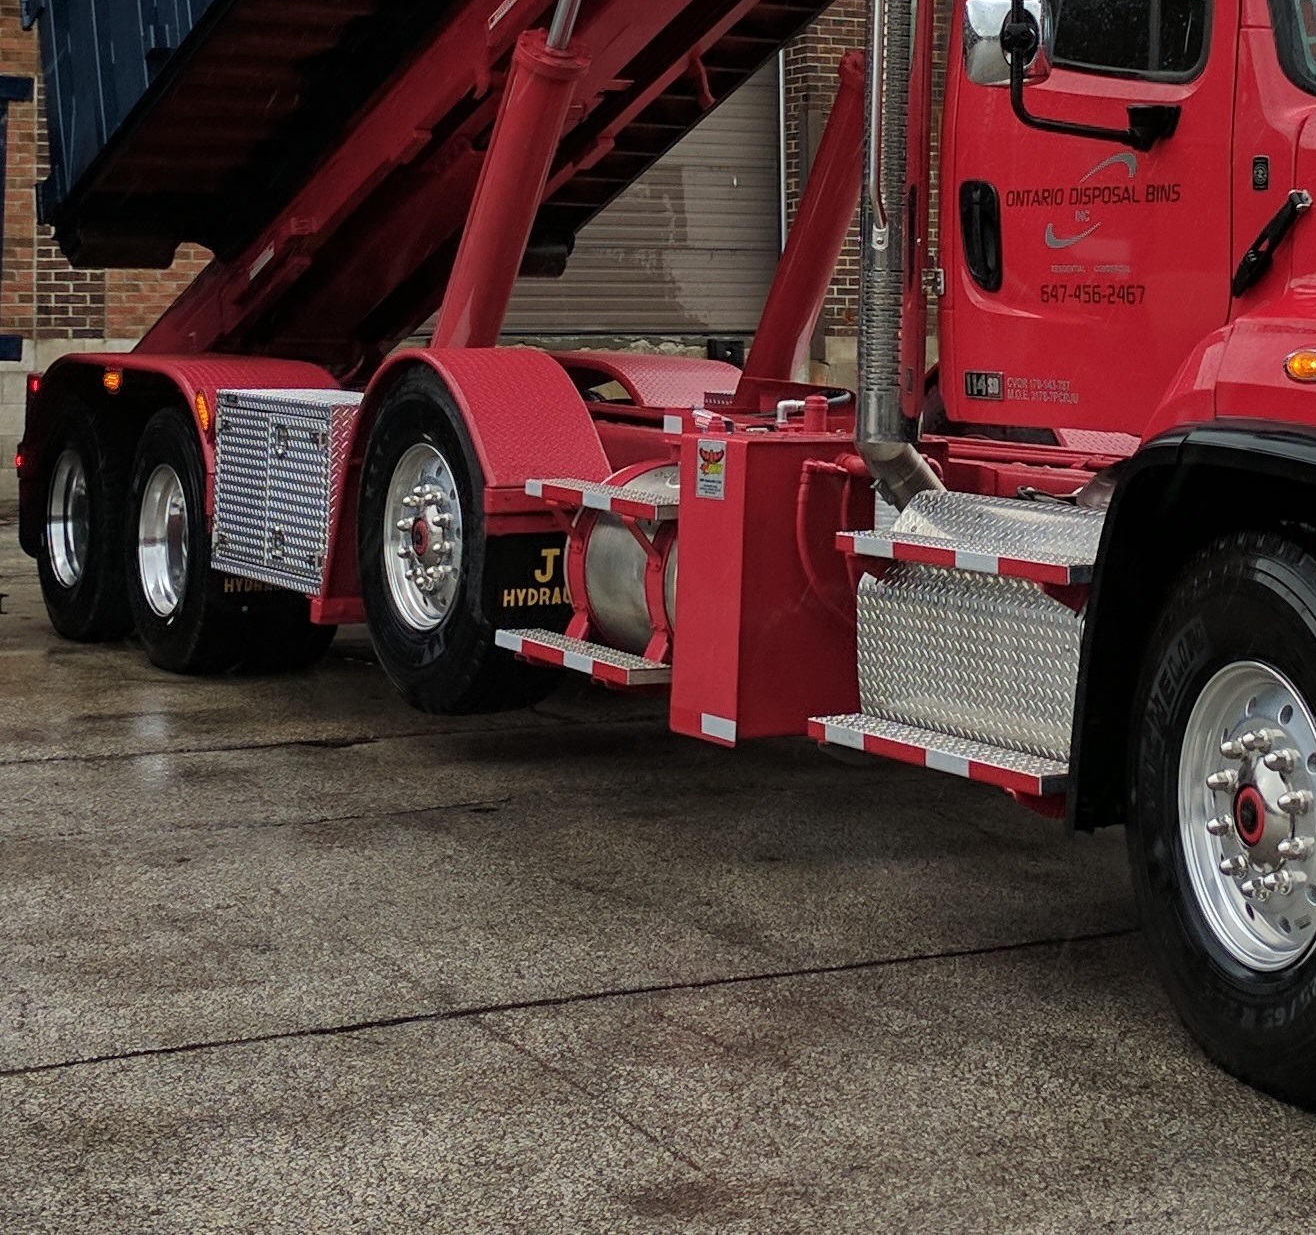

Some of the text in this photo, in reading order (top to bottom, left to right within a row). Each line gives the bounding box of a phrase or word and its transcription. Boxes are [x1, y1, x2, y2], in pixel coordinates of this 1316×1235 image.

[1006, 183, 1181, 208] ONTARIO DISPOSAL BINS
[1040, 284, 1146, 304] 647-456-2467
[534, 548, 561, 583] J
